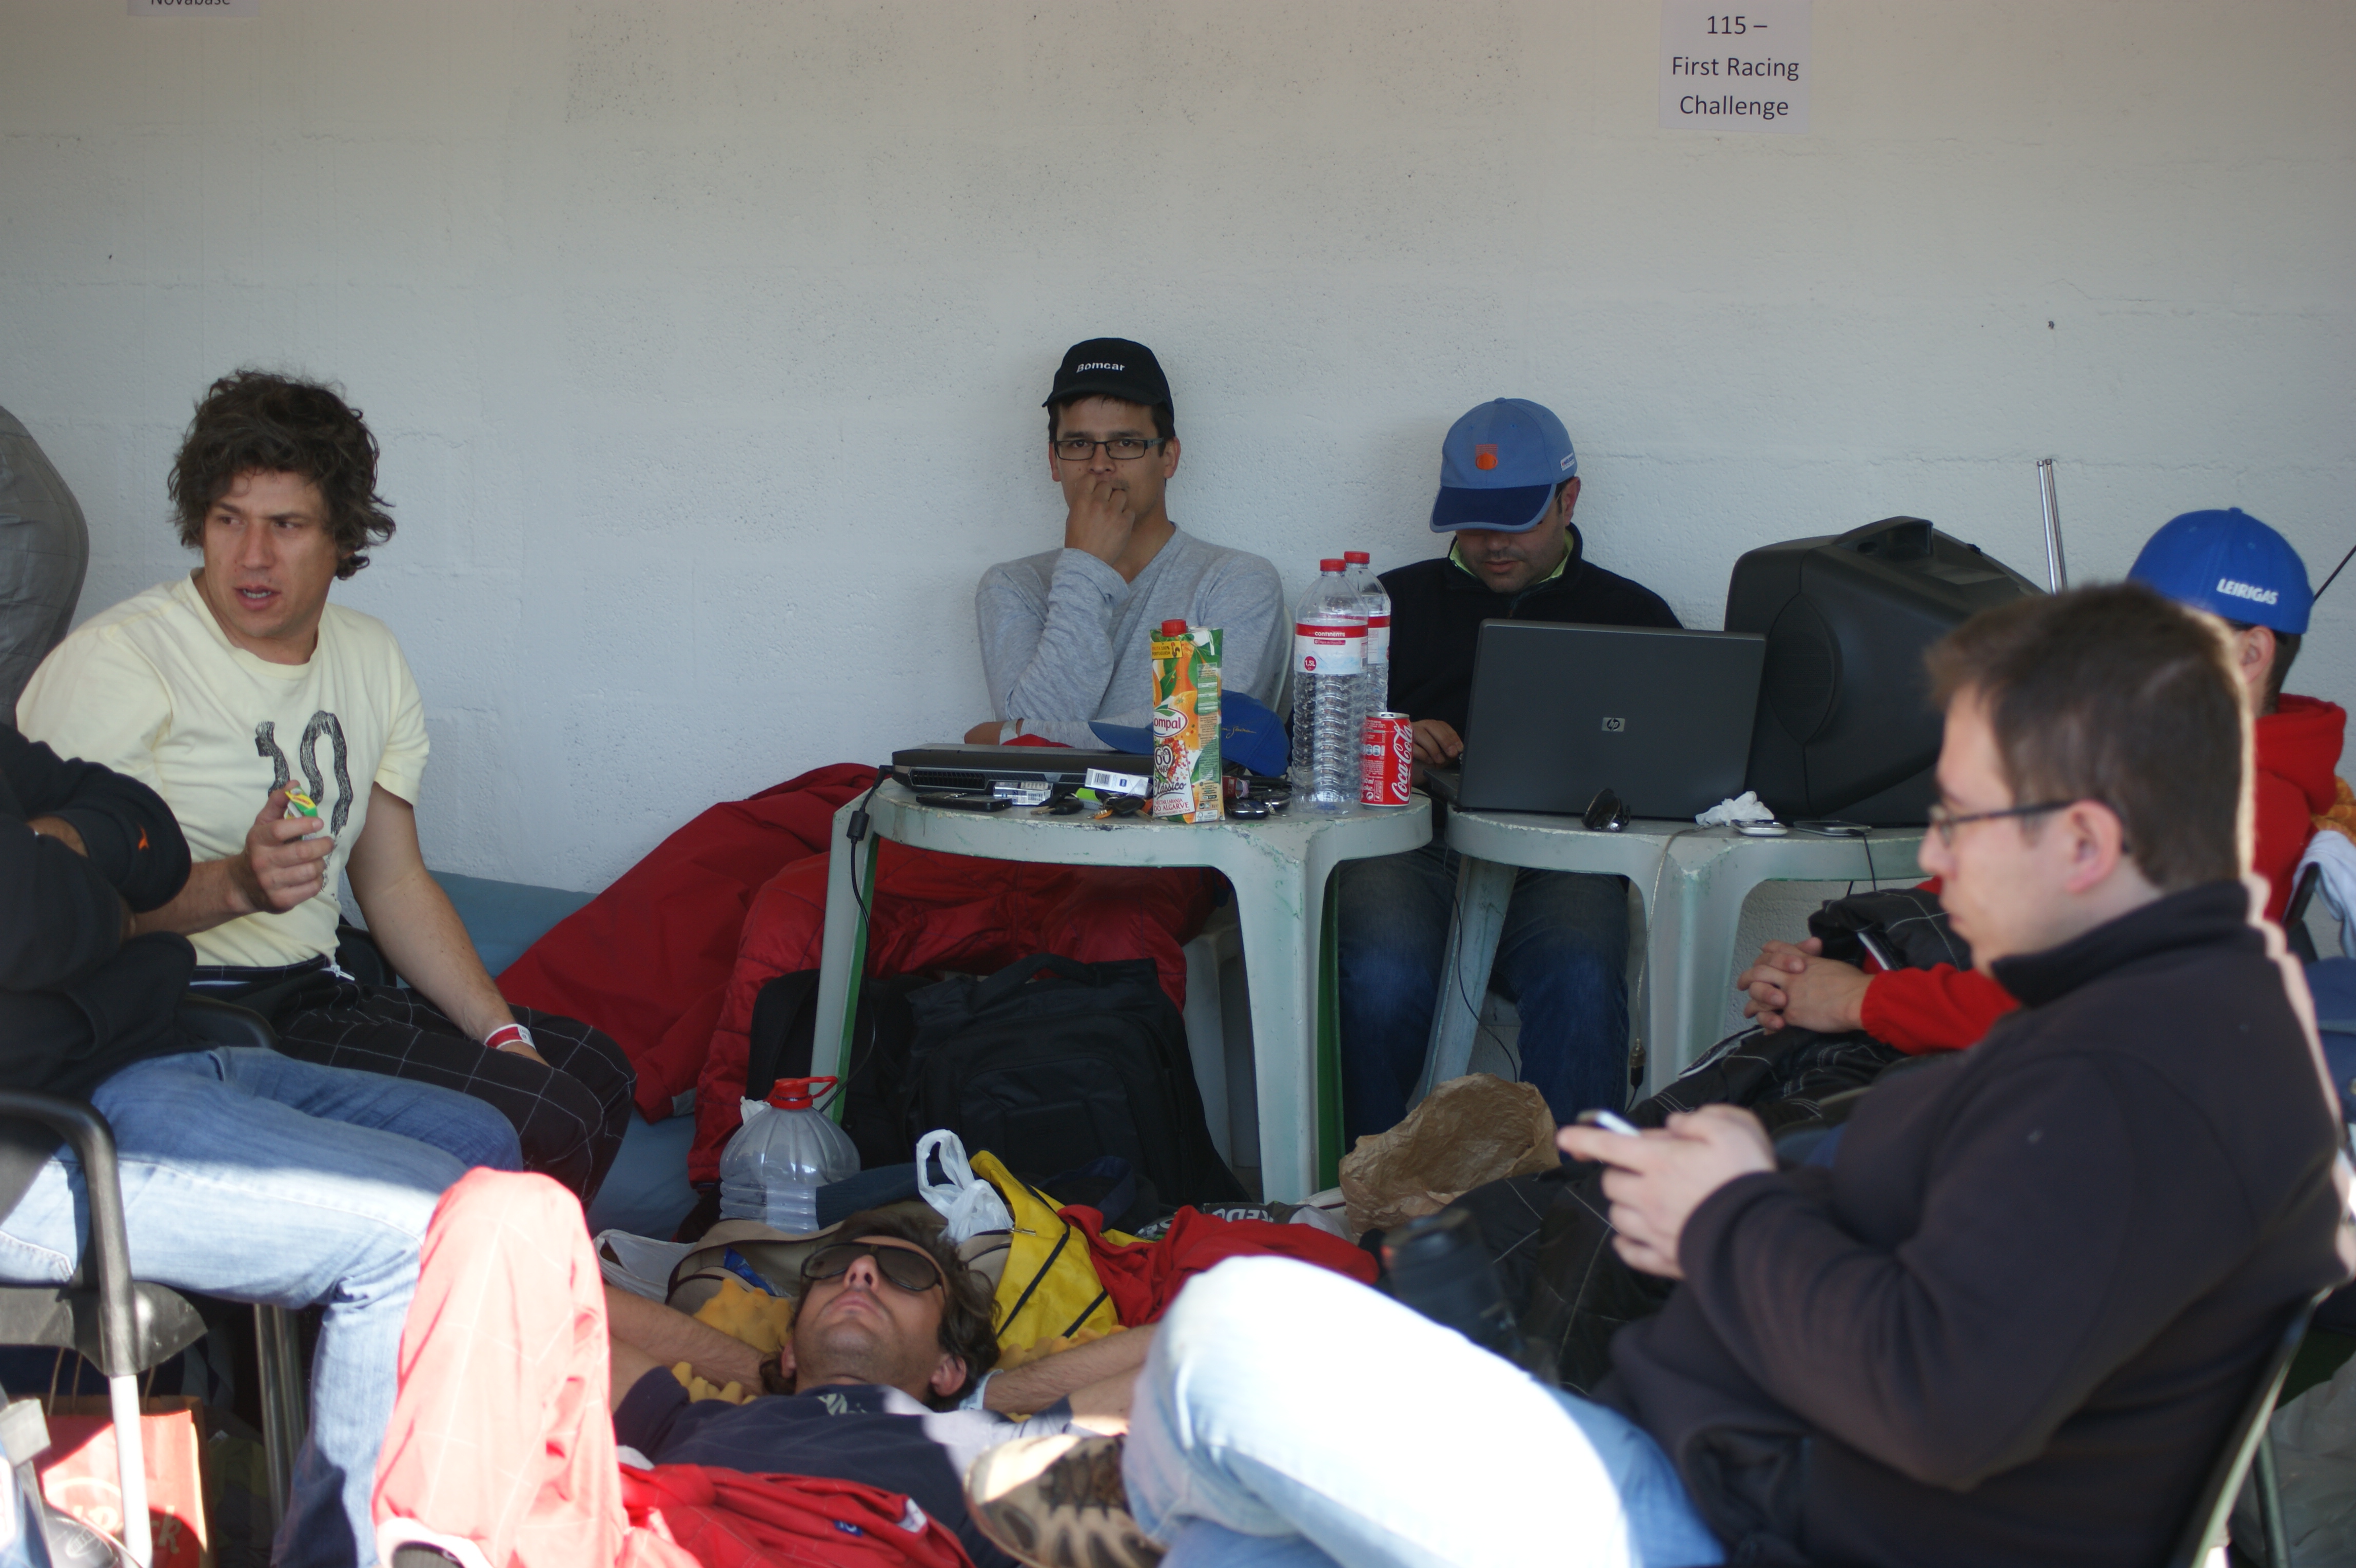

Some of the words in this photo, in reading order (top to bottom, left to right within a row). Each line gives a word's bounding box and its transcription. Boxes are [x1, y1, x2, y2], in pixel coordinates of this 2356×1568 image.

[1707, 16, 1746, 34] 115
[1673, 56, 1719, 76] First
[1727, 57, 1799, 82] Racing
[1680, 95, 1789, 120] Challenge
[1076, 362, 1126, 374] Bomcar
[2216, 578, 2279, 605] LEIRIGAS
[1154, 717, 1181, 732] ompal
[1608, 718, 1619, 731] hp
[1155, 747, 1171, 766] 60
[1163, 801, 1189, 811] ALGARVE
